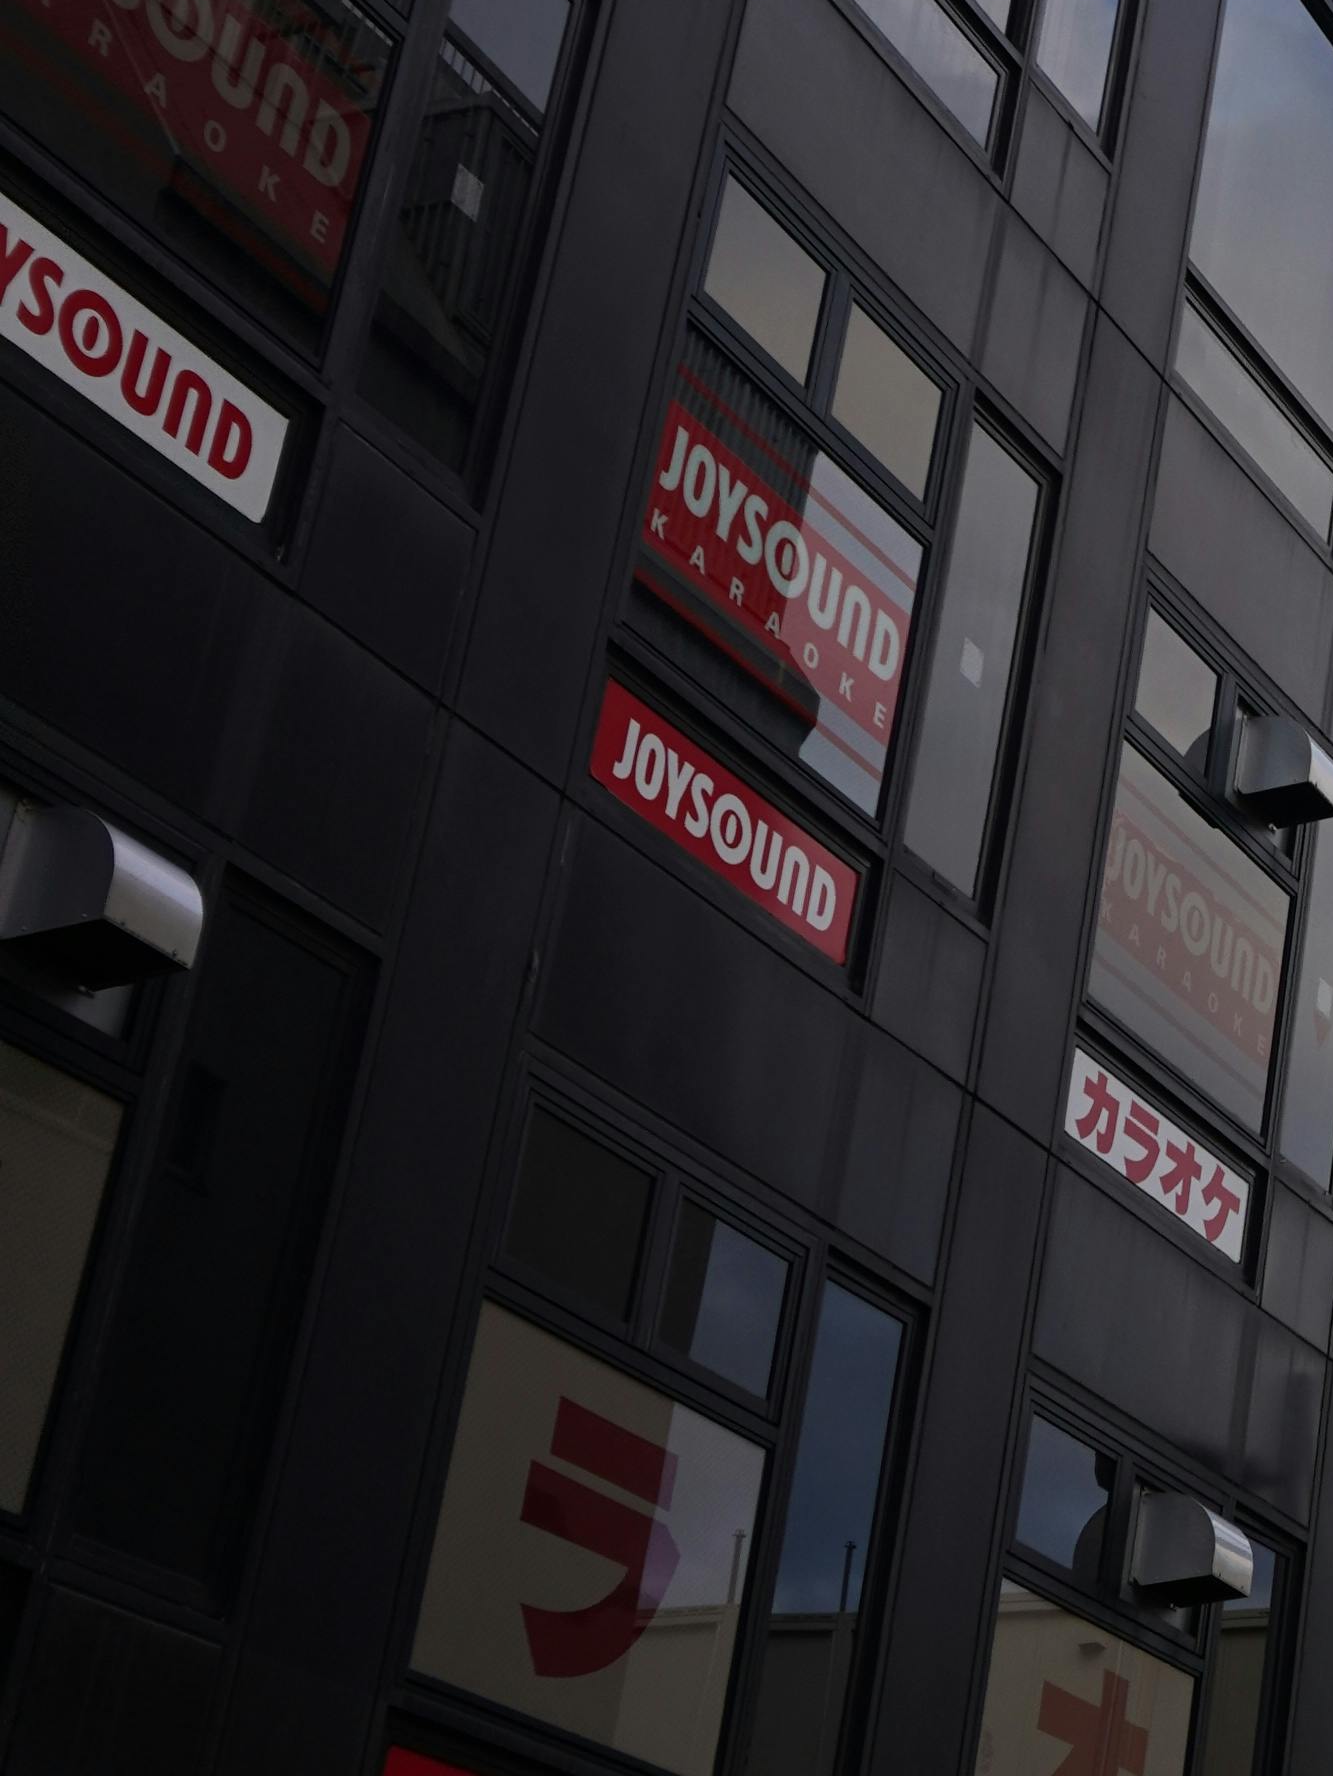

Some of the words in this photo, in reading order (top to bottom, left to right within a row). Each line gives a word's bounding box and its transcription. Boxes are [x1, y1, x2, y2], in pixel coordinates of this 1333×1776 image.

[649, 507, 886, 727] KARAOKE
[658, 425, 900, 684] JOYSOUND
[612, 718, 838, 932] JOYSOUND
[1106, 826, 1273, 1015] JOYSOUND
[1075, 1070, 1242, 1240] カラオケ
